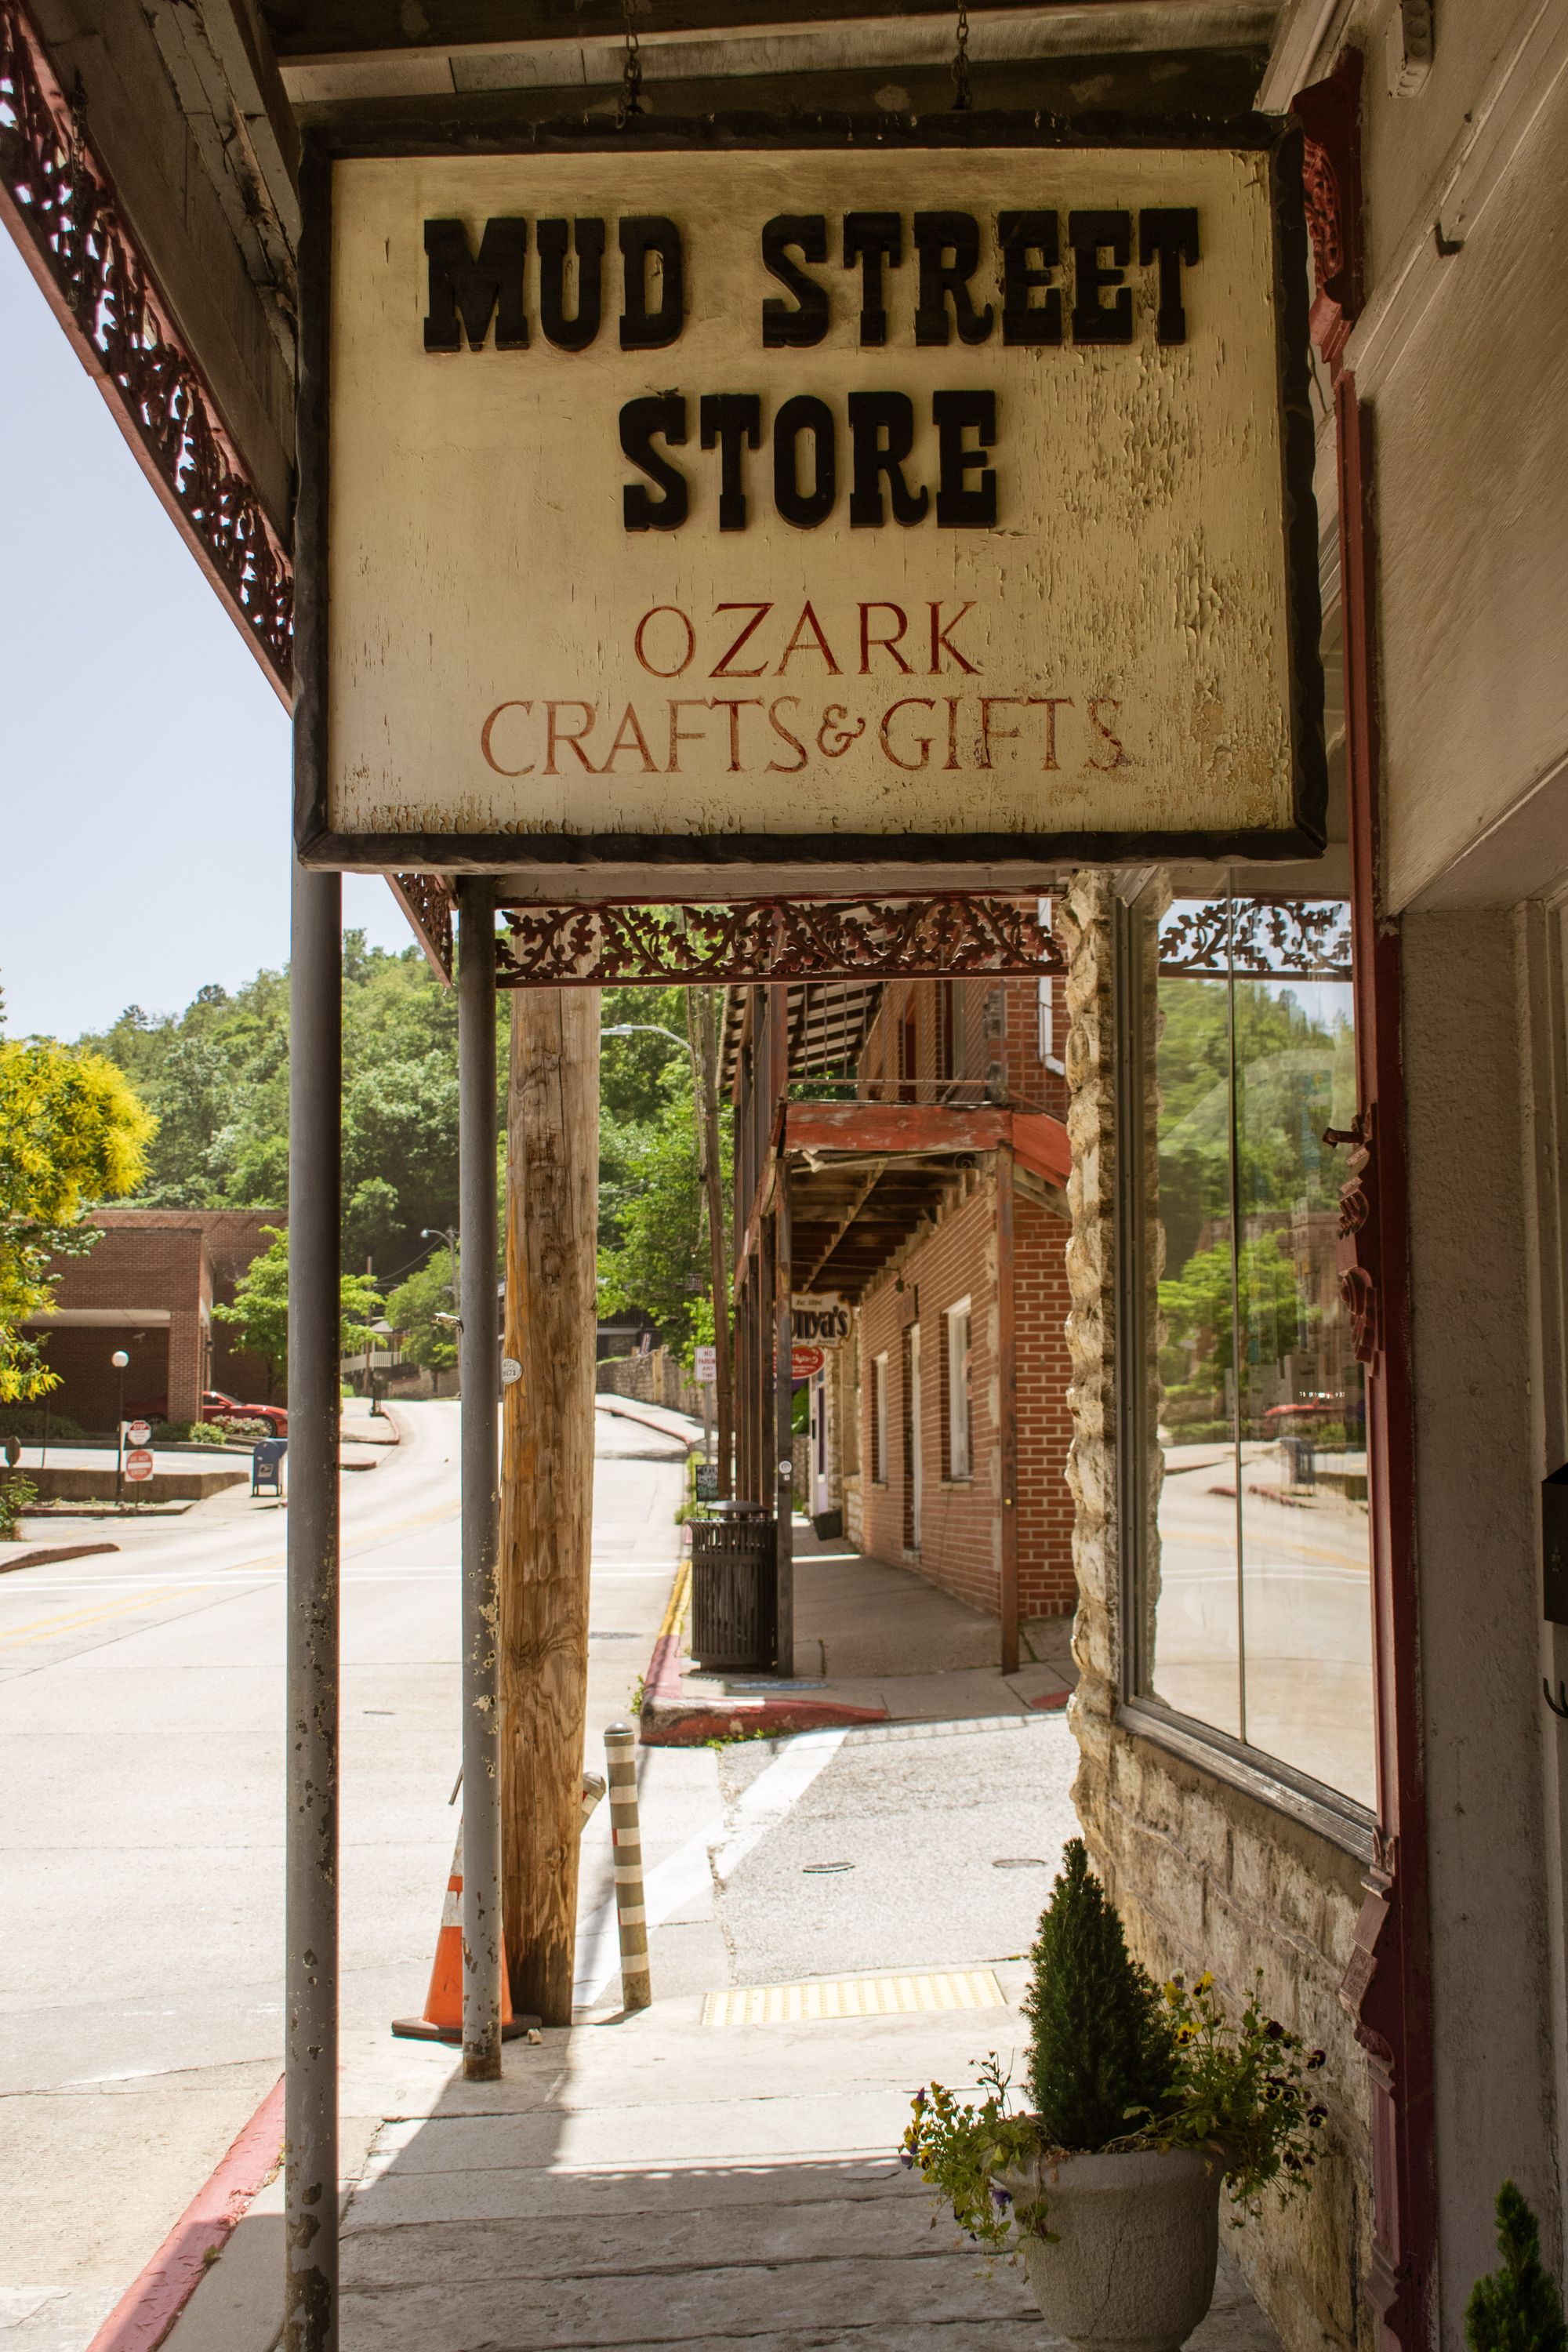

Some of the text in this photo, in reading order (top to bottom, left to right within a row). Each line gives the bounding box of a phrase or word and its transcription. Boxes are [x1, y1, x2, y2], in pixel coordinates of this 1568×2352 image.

[423, 207, 1200, 353] MUD STREET
[618, 389, 998, 532] STORE
[634, 601, 982, 679] OZARK
[479, 695, 810, 778] CRAFTS
[878, 695, 1134, 773] GIFTS
[790, 1305, 848, 1338] onya's
